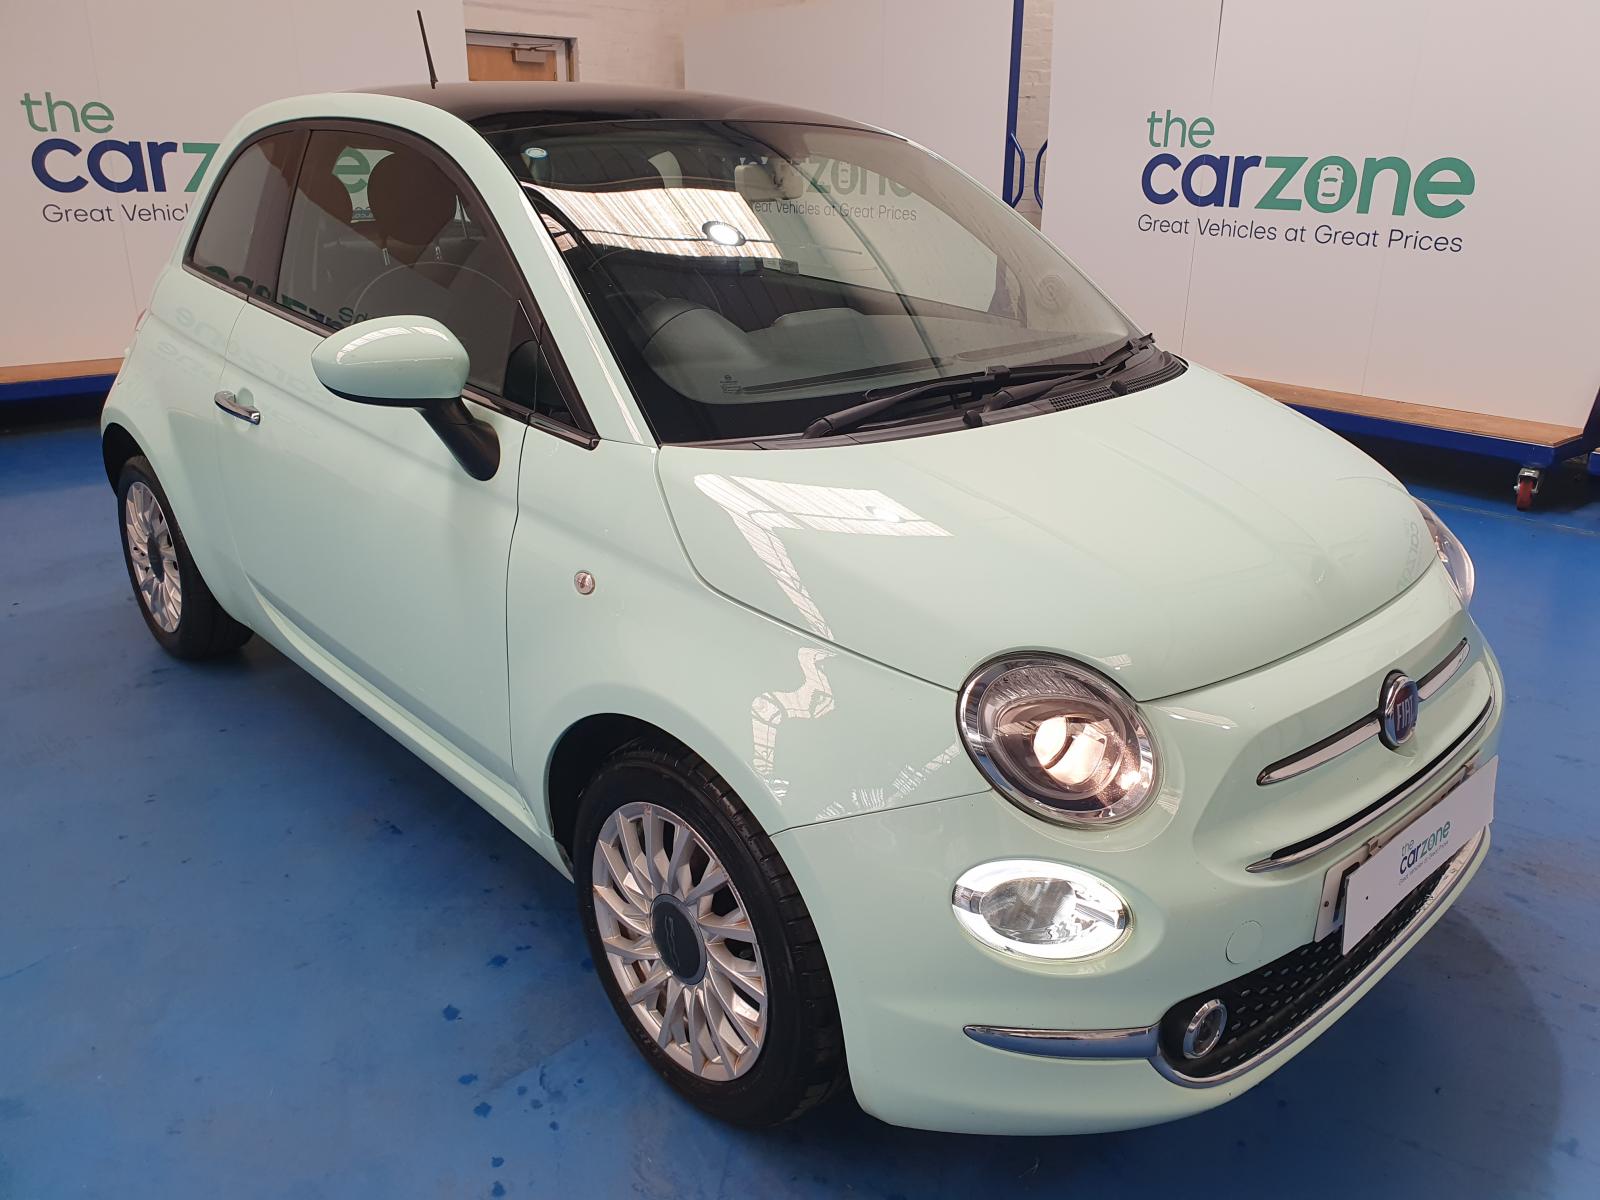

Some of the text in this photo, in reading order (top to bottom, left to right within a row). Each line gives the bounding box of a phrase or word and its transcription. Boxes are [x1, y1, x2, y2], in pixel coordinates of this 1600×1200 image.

[20, 91, 115, 133] the
[1147, 109, 1215, 148] the
[1141, 153, 1476, 219] carzone
[43, 203, 115, 222] Great
[776, 201, 821, 215] Vehicles
[824, 204, 838, 217] at
[839, 202, 875, 219] Great
[878, 204, 918, 221] Prices
[1137, 214, 1463, 253] Great Vehicles at Great Prices
[1396, 694, 1414, 732] FIAT
[1400, 821, 1451, 875] carzone
